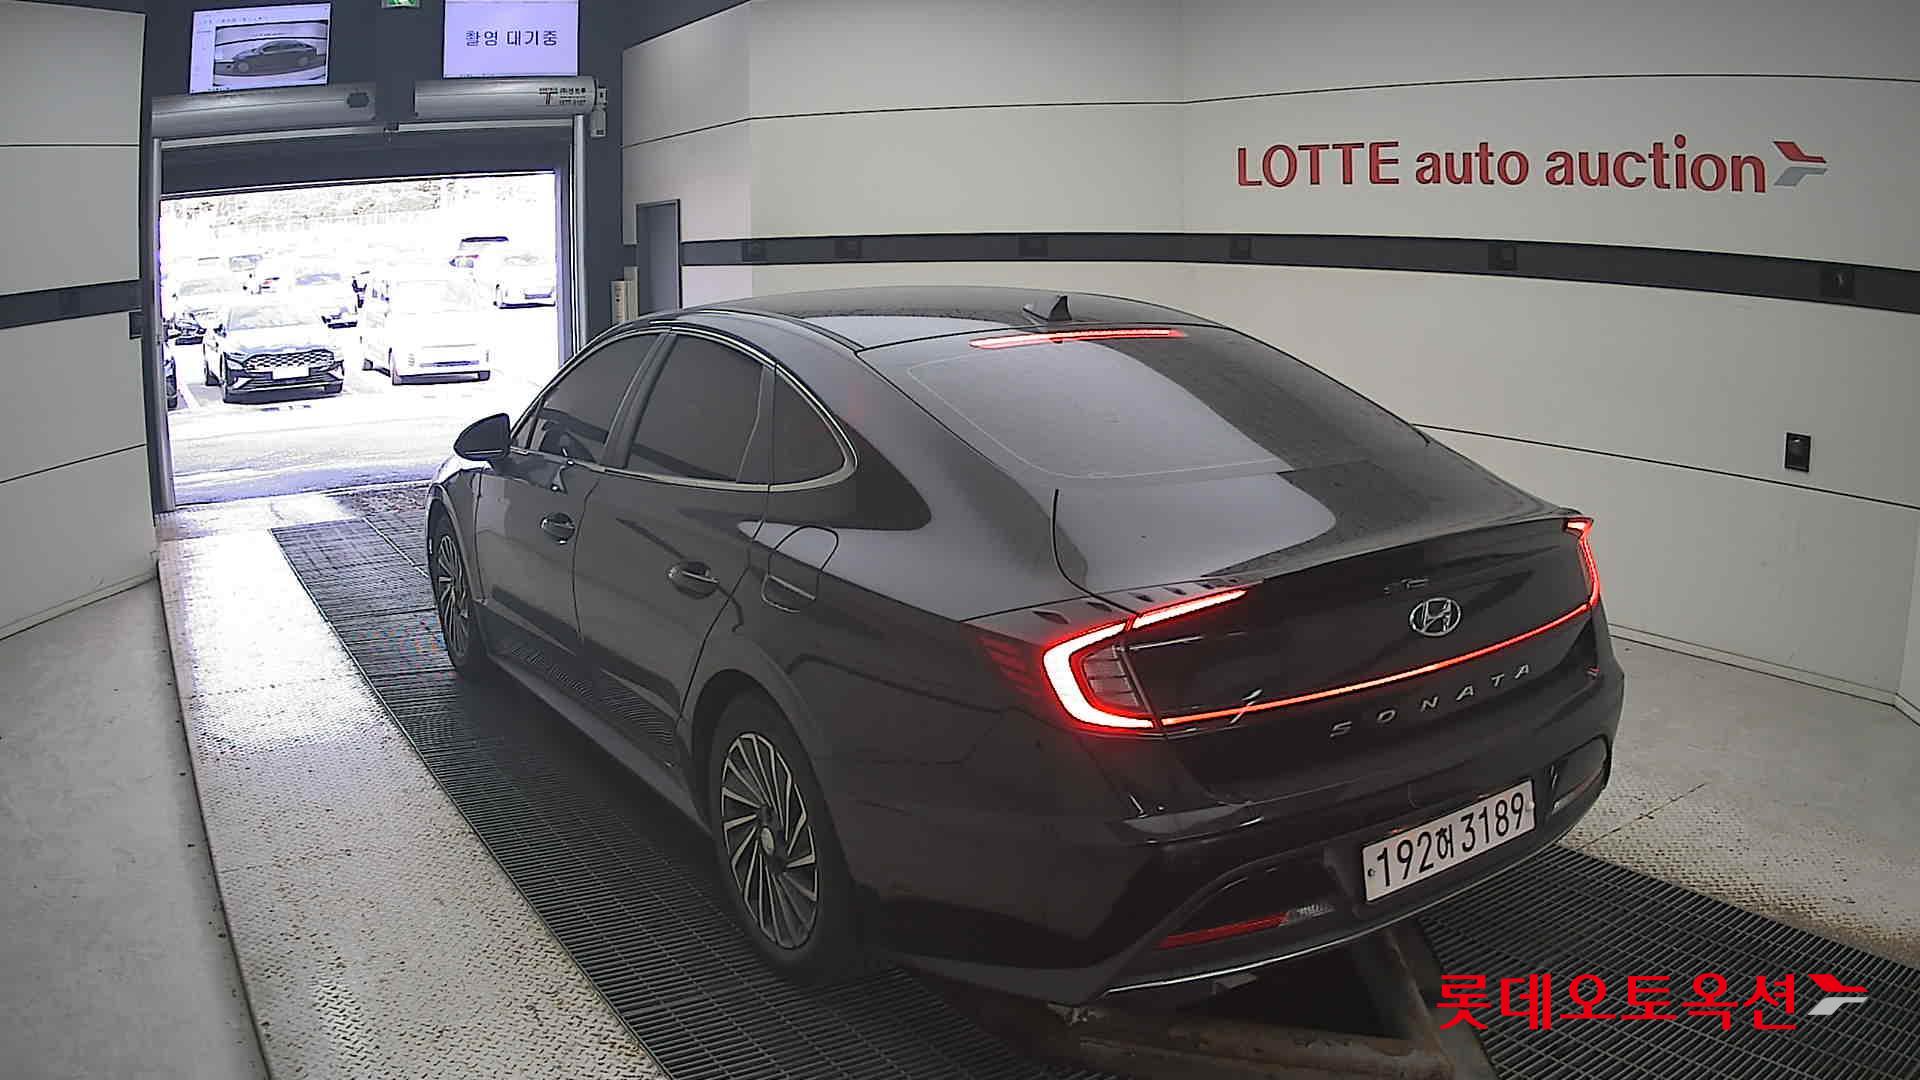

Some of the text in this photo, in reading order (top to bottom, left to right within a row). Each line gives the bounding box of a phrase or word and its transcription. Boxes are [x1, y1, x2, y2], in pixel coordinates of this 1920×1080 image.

[465, 29, 558, 47] 촬영 대기중
[1237, 133, 1767, 194] LOTTE auto auction
[1329, 663, 1531, 738] SONATA
[1460, 791, 1525, 854] 3189
